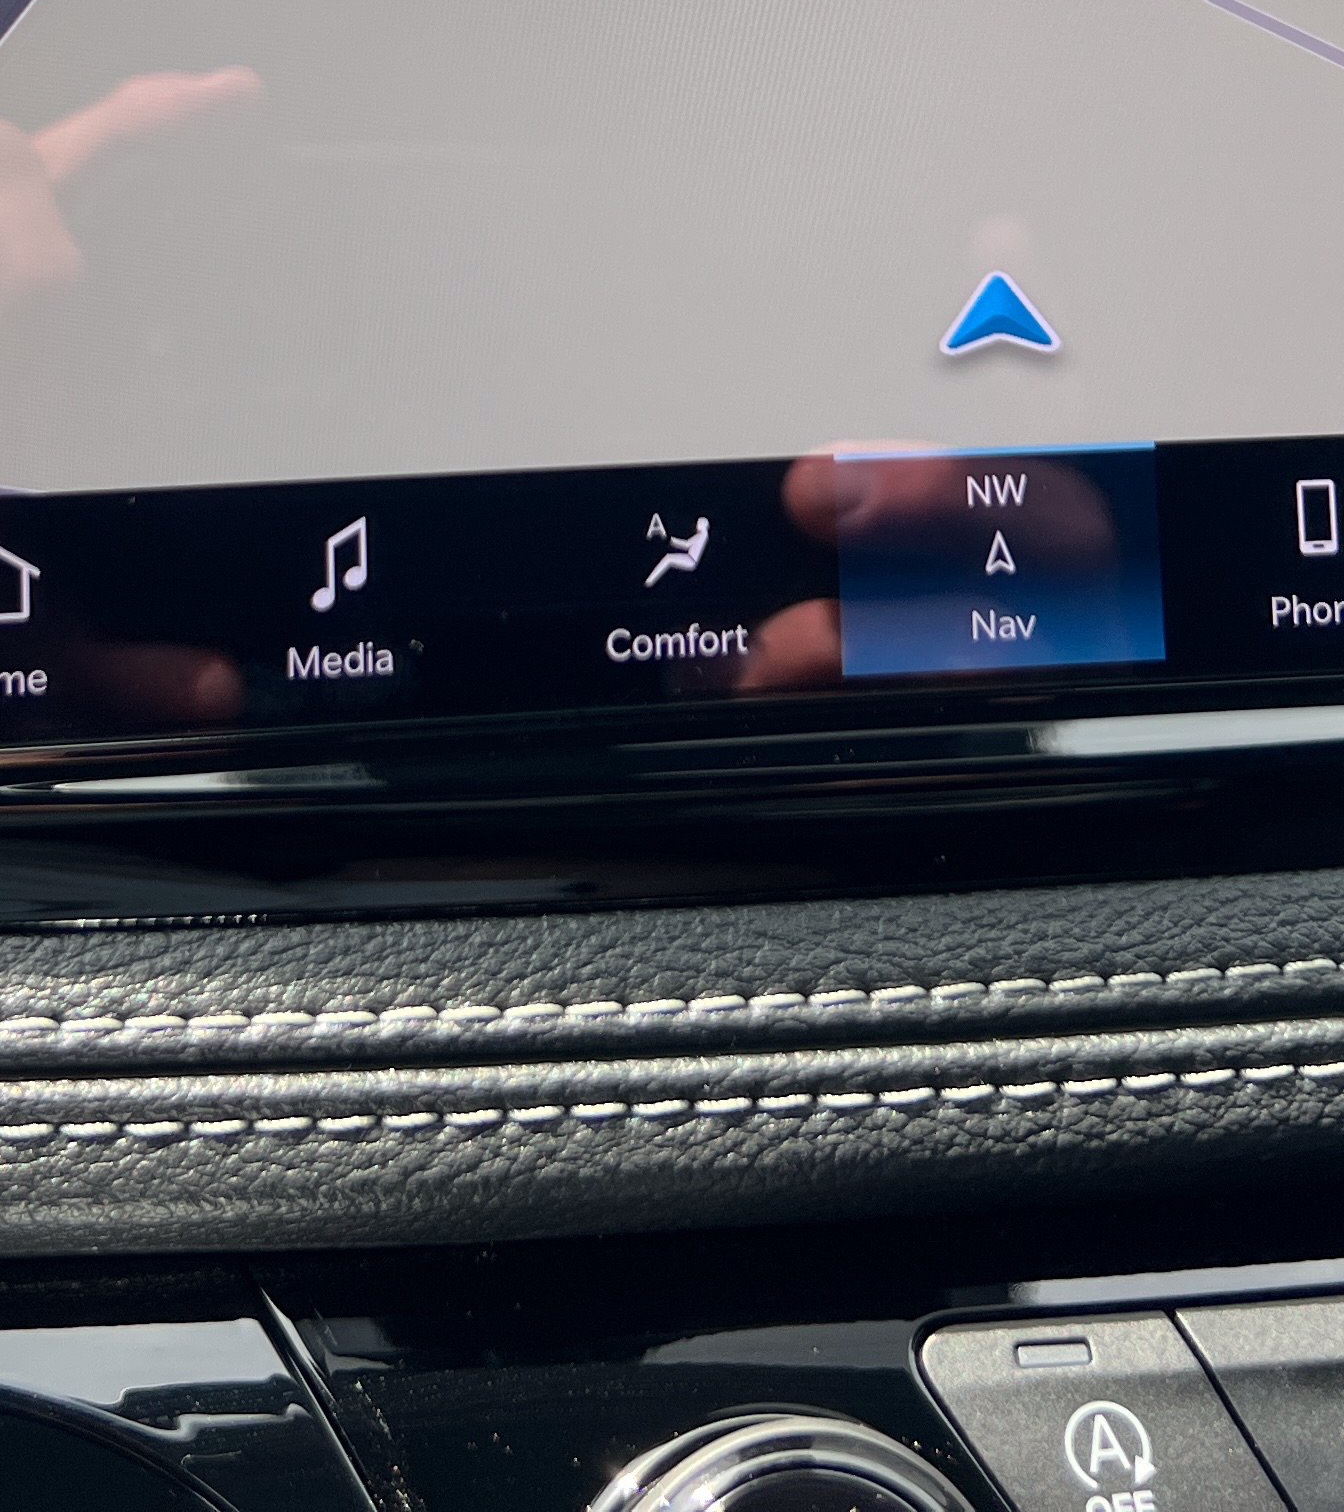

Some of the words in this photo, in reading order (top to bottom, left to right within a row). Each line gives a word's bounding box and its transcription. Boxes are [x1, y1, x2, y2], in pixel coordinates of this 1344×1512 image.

[966, 474, 1027, 508] NW
[606, 623, 748, 662] Comfort
[971, 610, 1036, 642] Nav
[287, 642, 395, 680] Media
